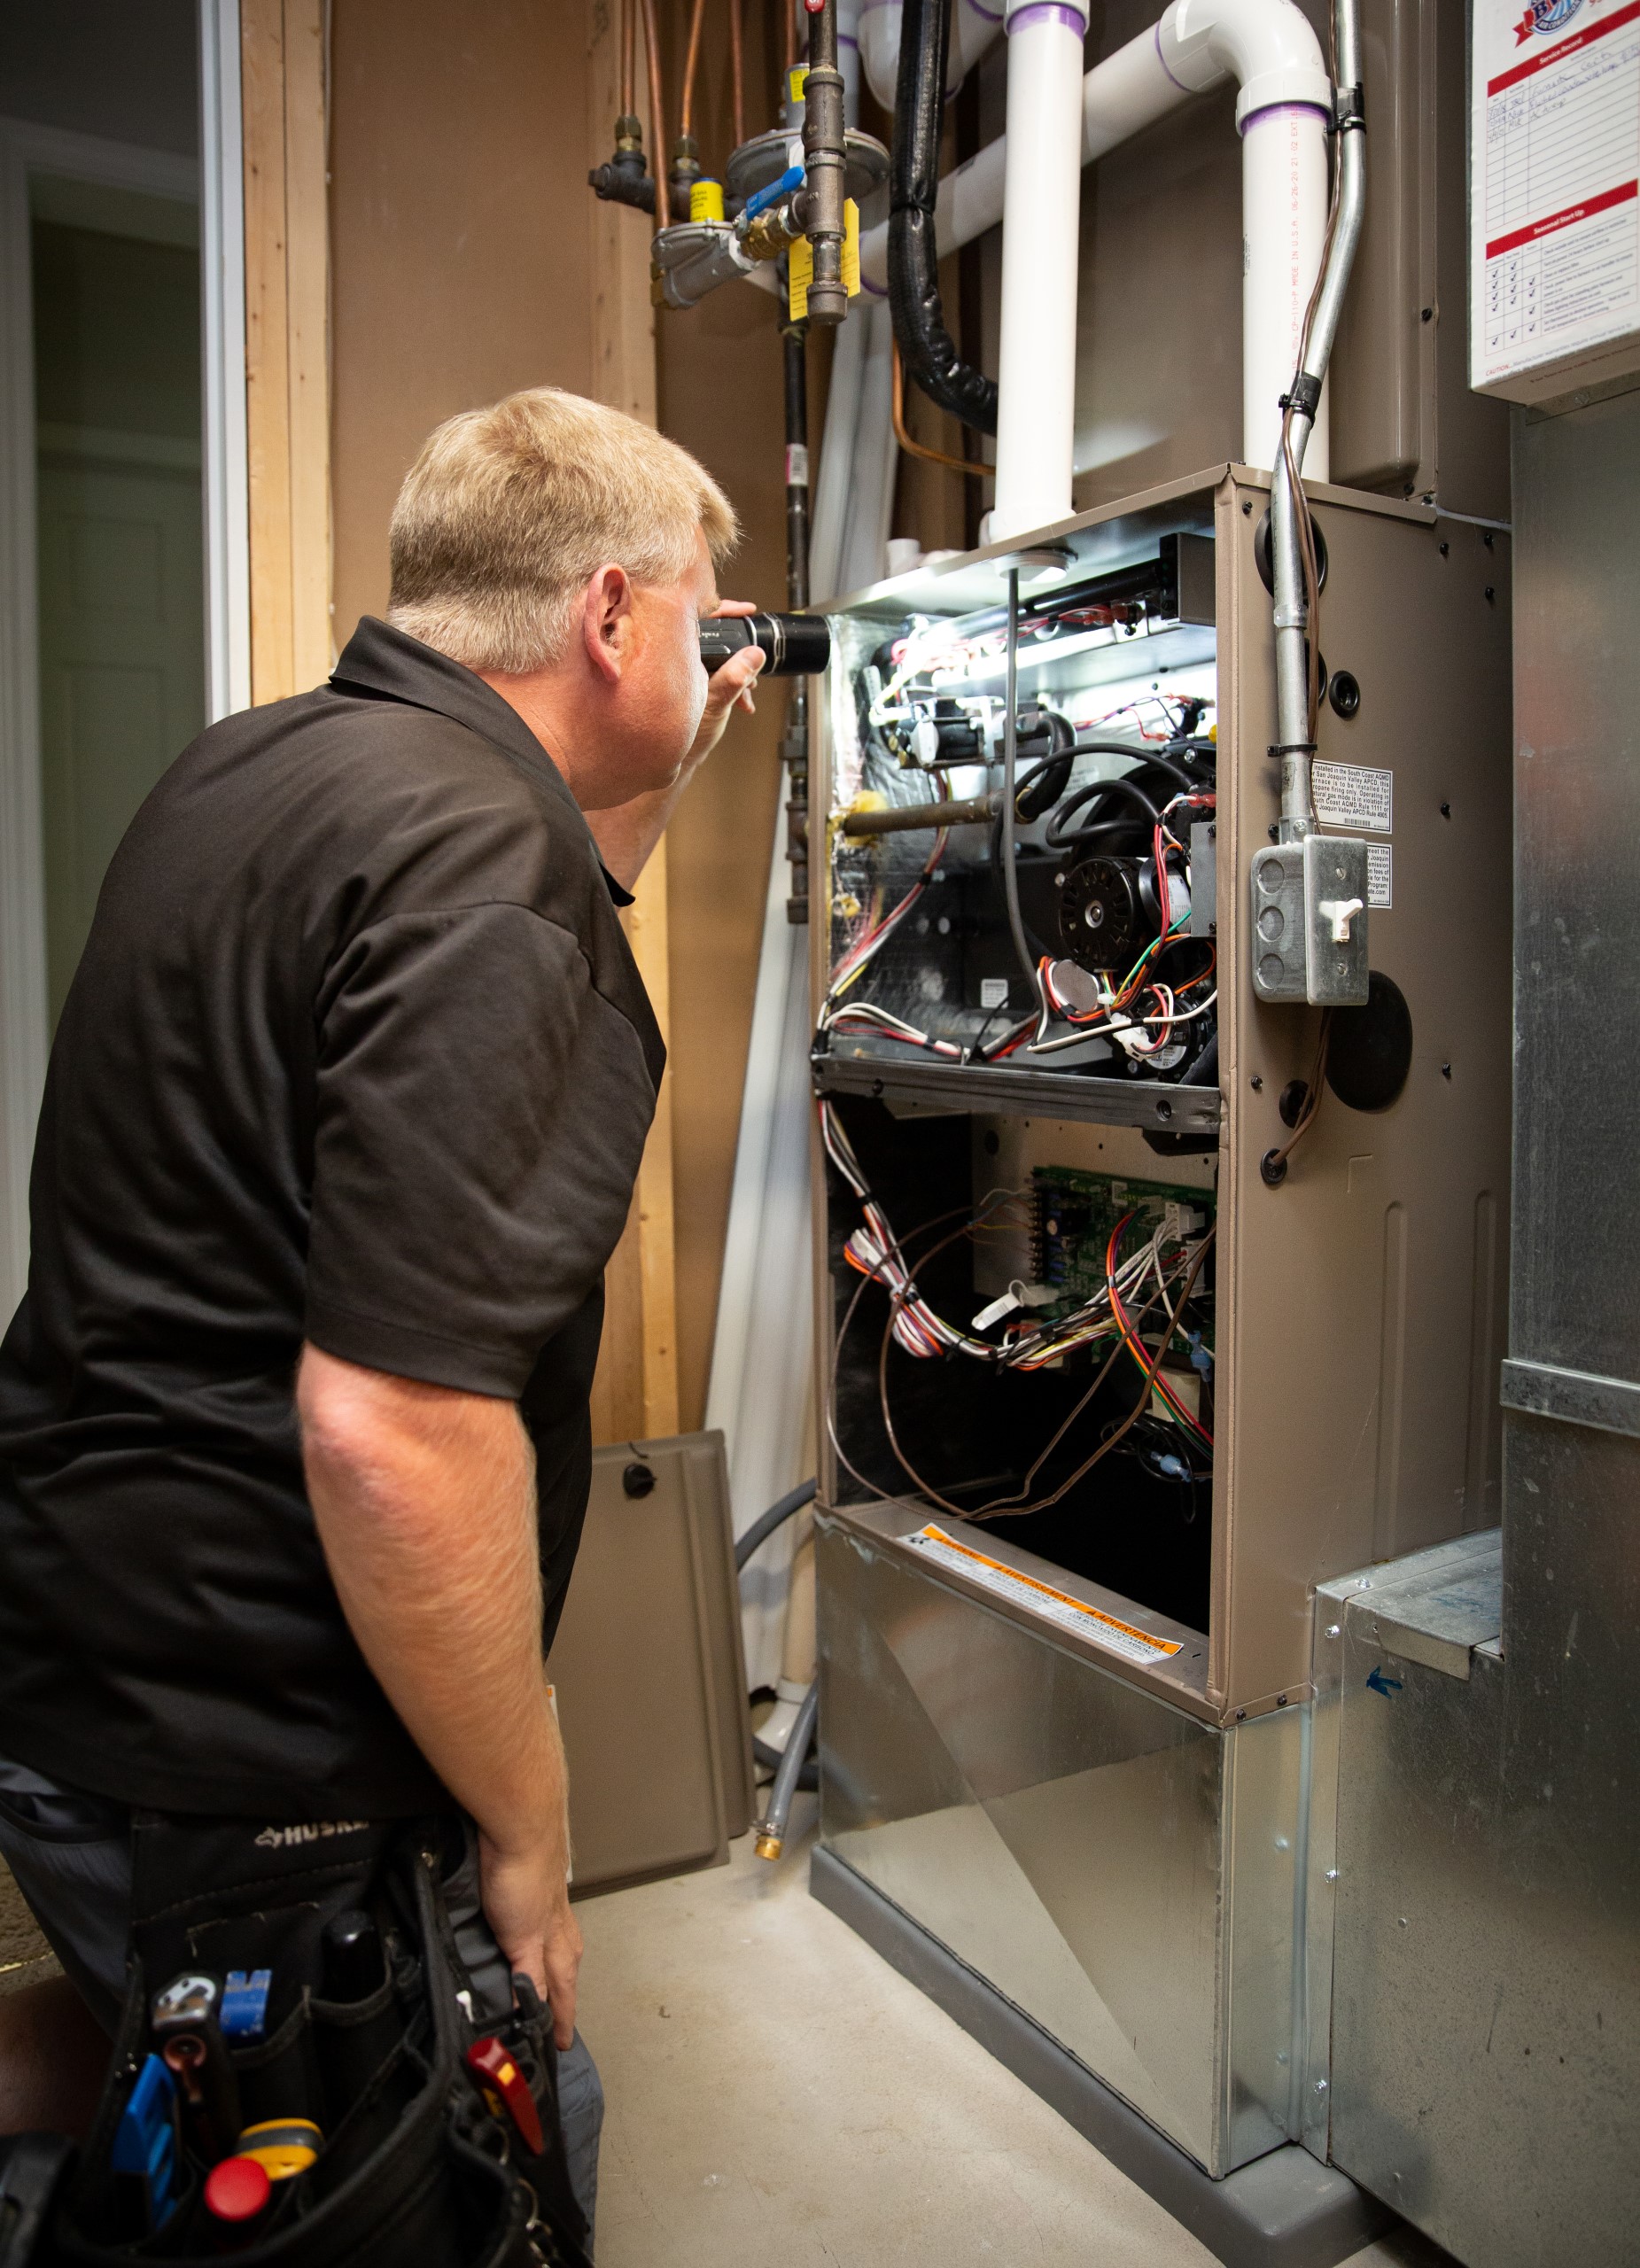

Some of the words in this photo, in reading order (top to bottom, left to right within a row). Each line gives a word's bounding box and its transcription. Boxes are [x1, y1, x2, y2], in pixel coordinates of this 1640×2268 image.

[1559, 214, 1574, 223] Start
[1291, 251, 1298, 260] IN
[1314, 764, 1333, 773] installed
[1360, 790, 1383, 800] Operating
[1319, 804, 1337, 812] Joaquin
[1003, 1567, 1076, 1604] AVERTISSEMENT
[1096, 1613, 1167, 1650] ADVERTENCIA
[1122, 1636, 1155, 1656] CARBONO
